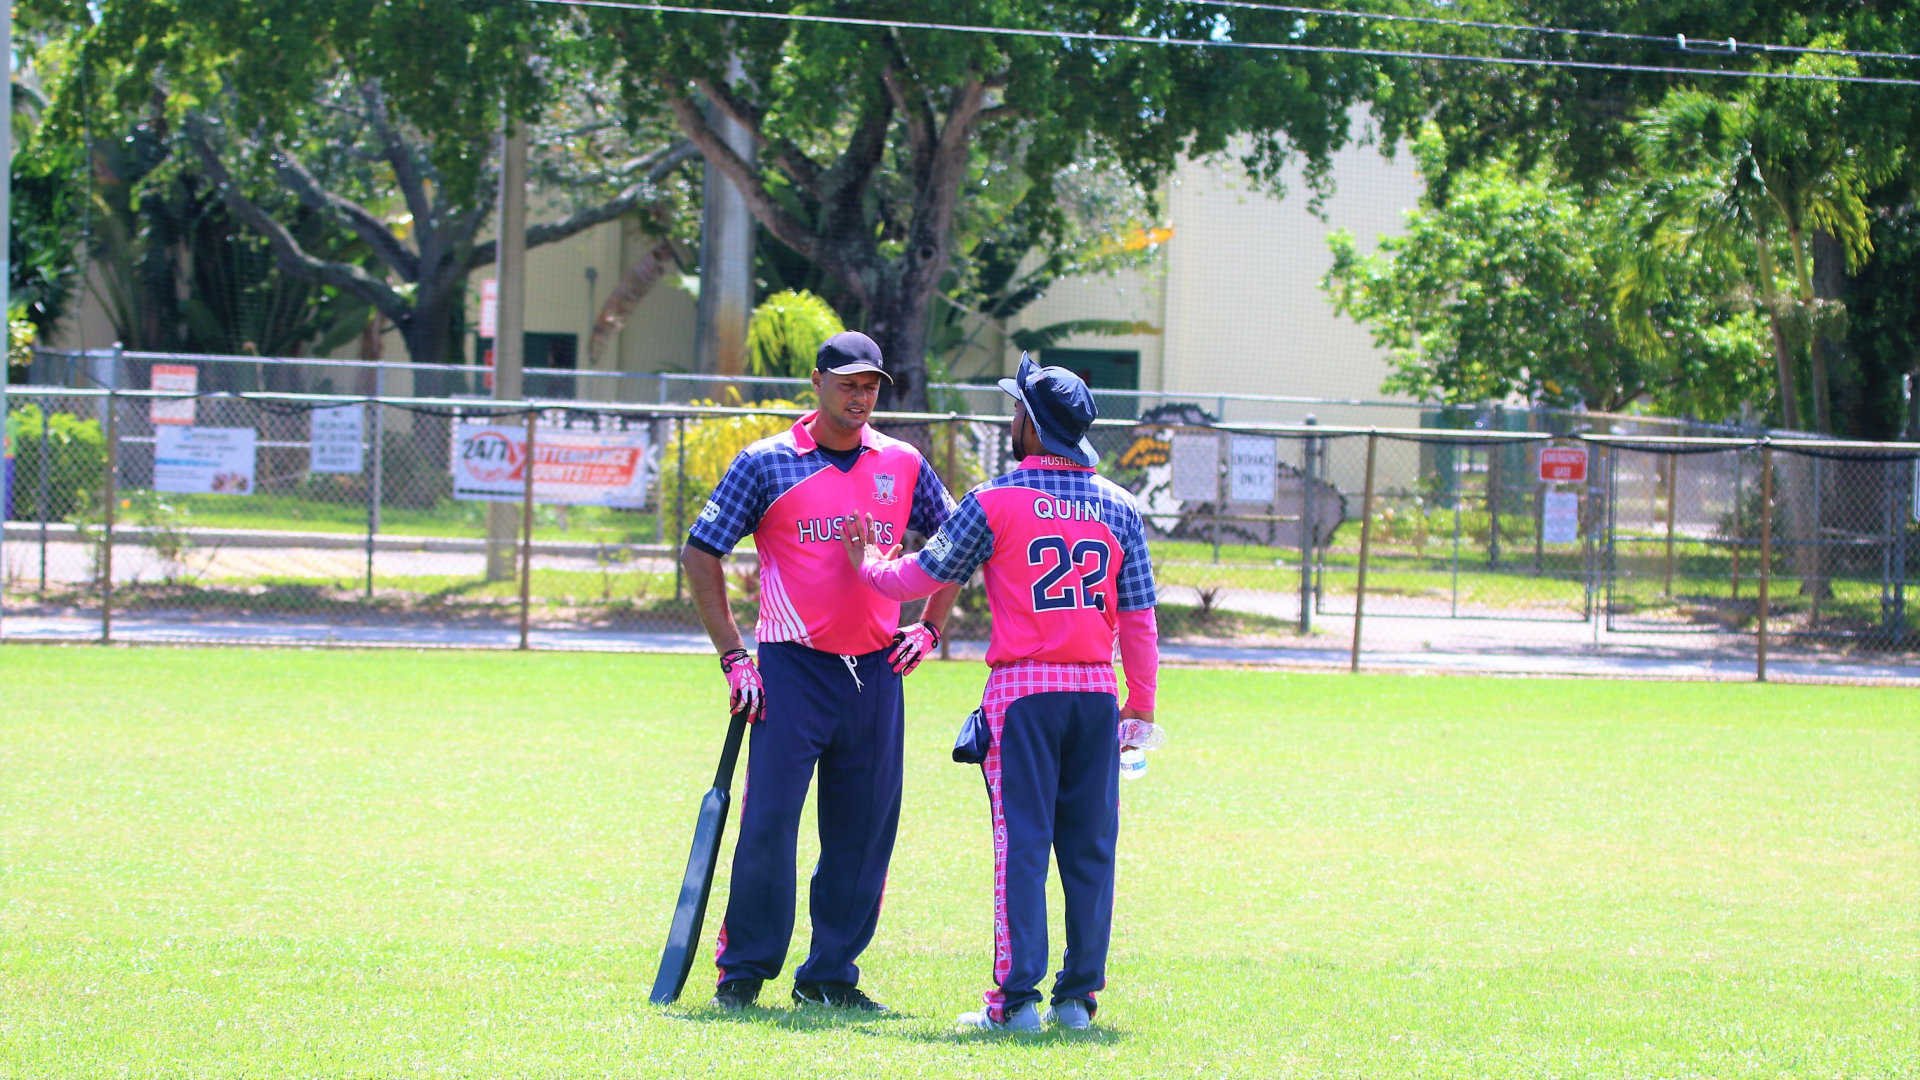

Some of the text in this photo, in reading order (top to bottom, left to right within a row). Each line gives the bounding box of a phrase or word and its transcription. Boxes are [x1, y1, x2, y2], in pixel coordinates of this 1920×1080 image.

[462, 438, 507, 462] 24/7
[1040, 456, 1081, 467] HUSTLE
[1033, 497, 1101, 522] QUIN
[797, 516, 893, 545] HUSRS
[1027, 535, 1111, 613] 22
